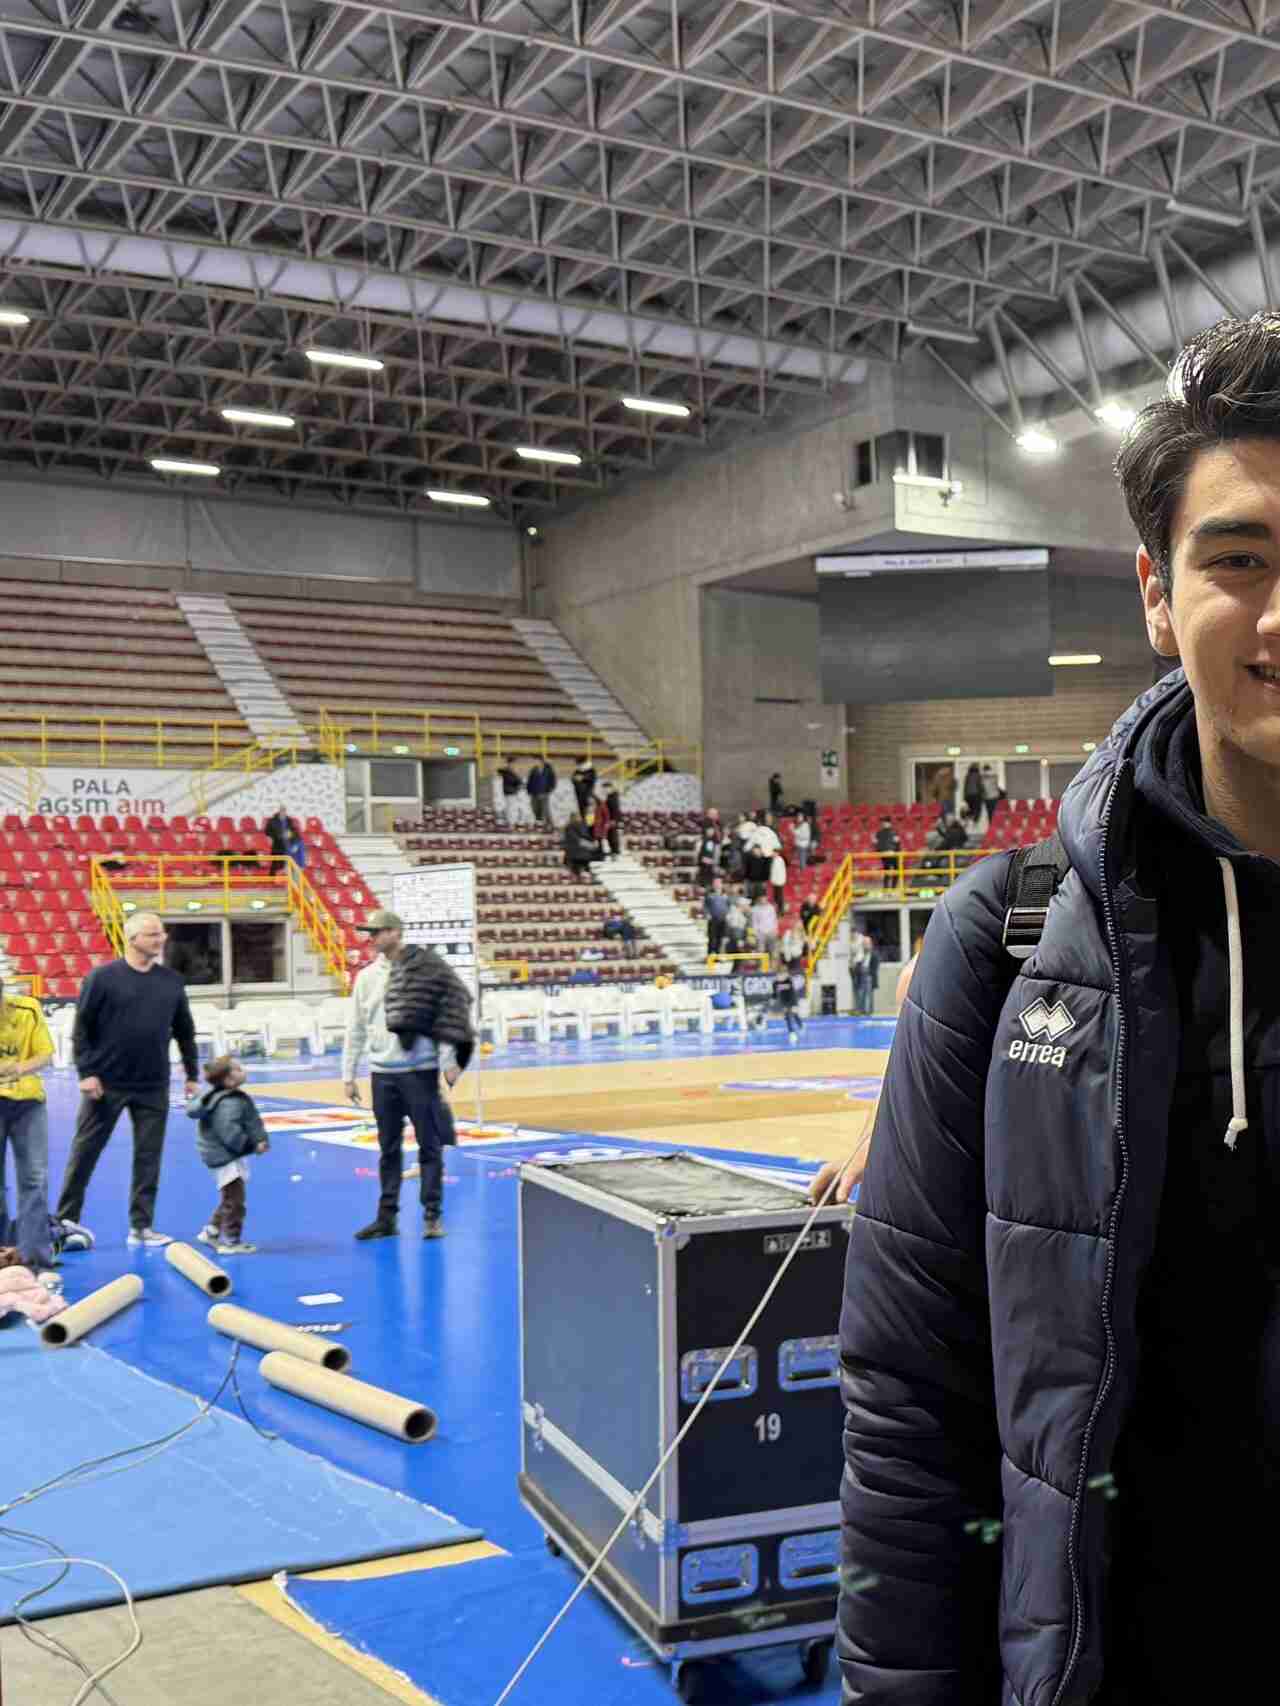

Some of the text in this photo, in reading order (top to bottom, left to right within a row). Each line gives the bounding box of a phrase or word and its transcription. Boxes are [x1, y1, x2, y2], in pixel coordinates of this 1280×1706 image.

[72, 778, 130, 795] PALA
[117, 798, 166, 814] aim
[1009, 1039, 1067, 1068] errea
[754, 1412, 781, 1443] 19
